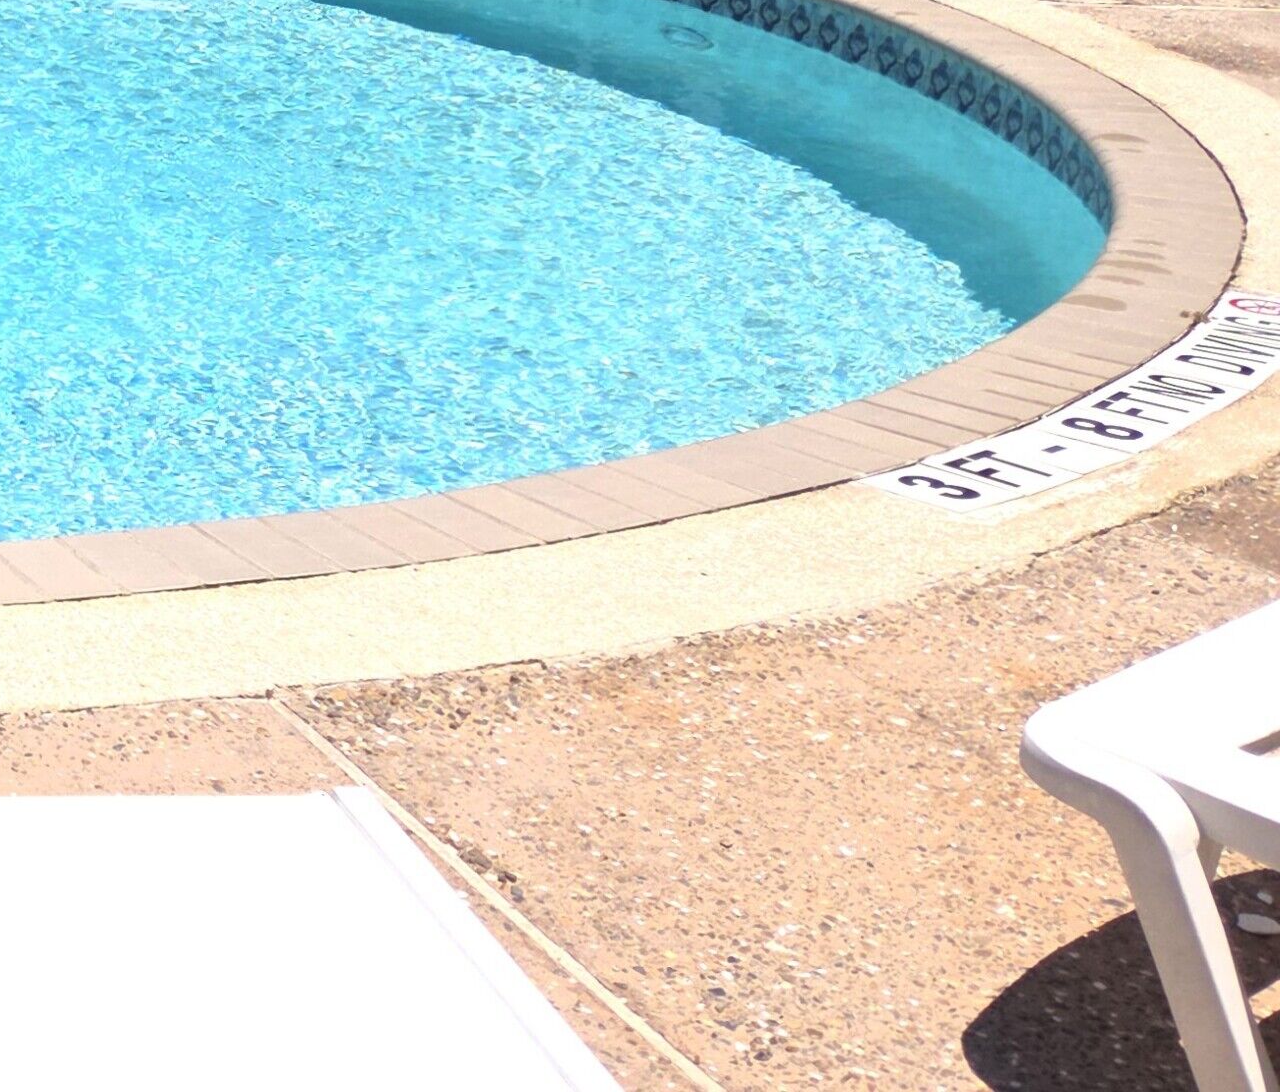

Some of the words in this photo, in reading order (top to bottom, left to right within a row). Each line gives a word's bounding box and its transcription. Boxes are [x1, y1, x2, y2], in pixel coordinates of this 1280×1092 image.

[1175, 316, 1280, 376] DIVING
[1128, 374, 1226, 405] NO
[1092, 391, 1190, 425] FT
[1061, 416, 1144, 440] 8
[942, 449, 1053, 488] FT
[898, 474, 981, 500] 3
